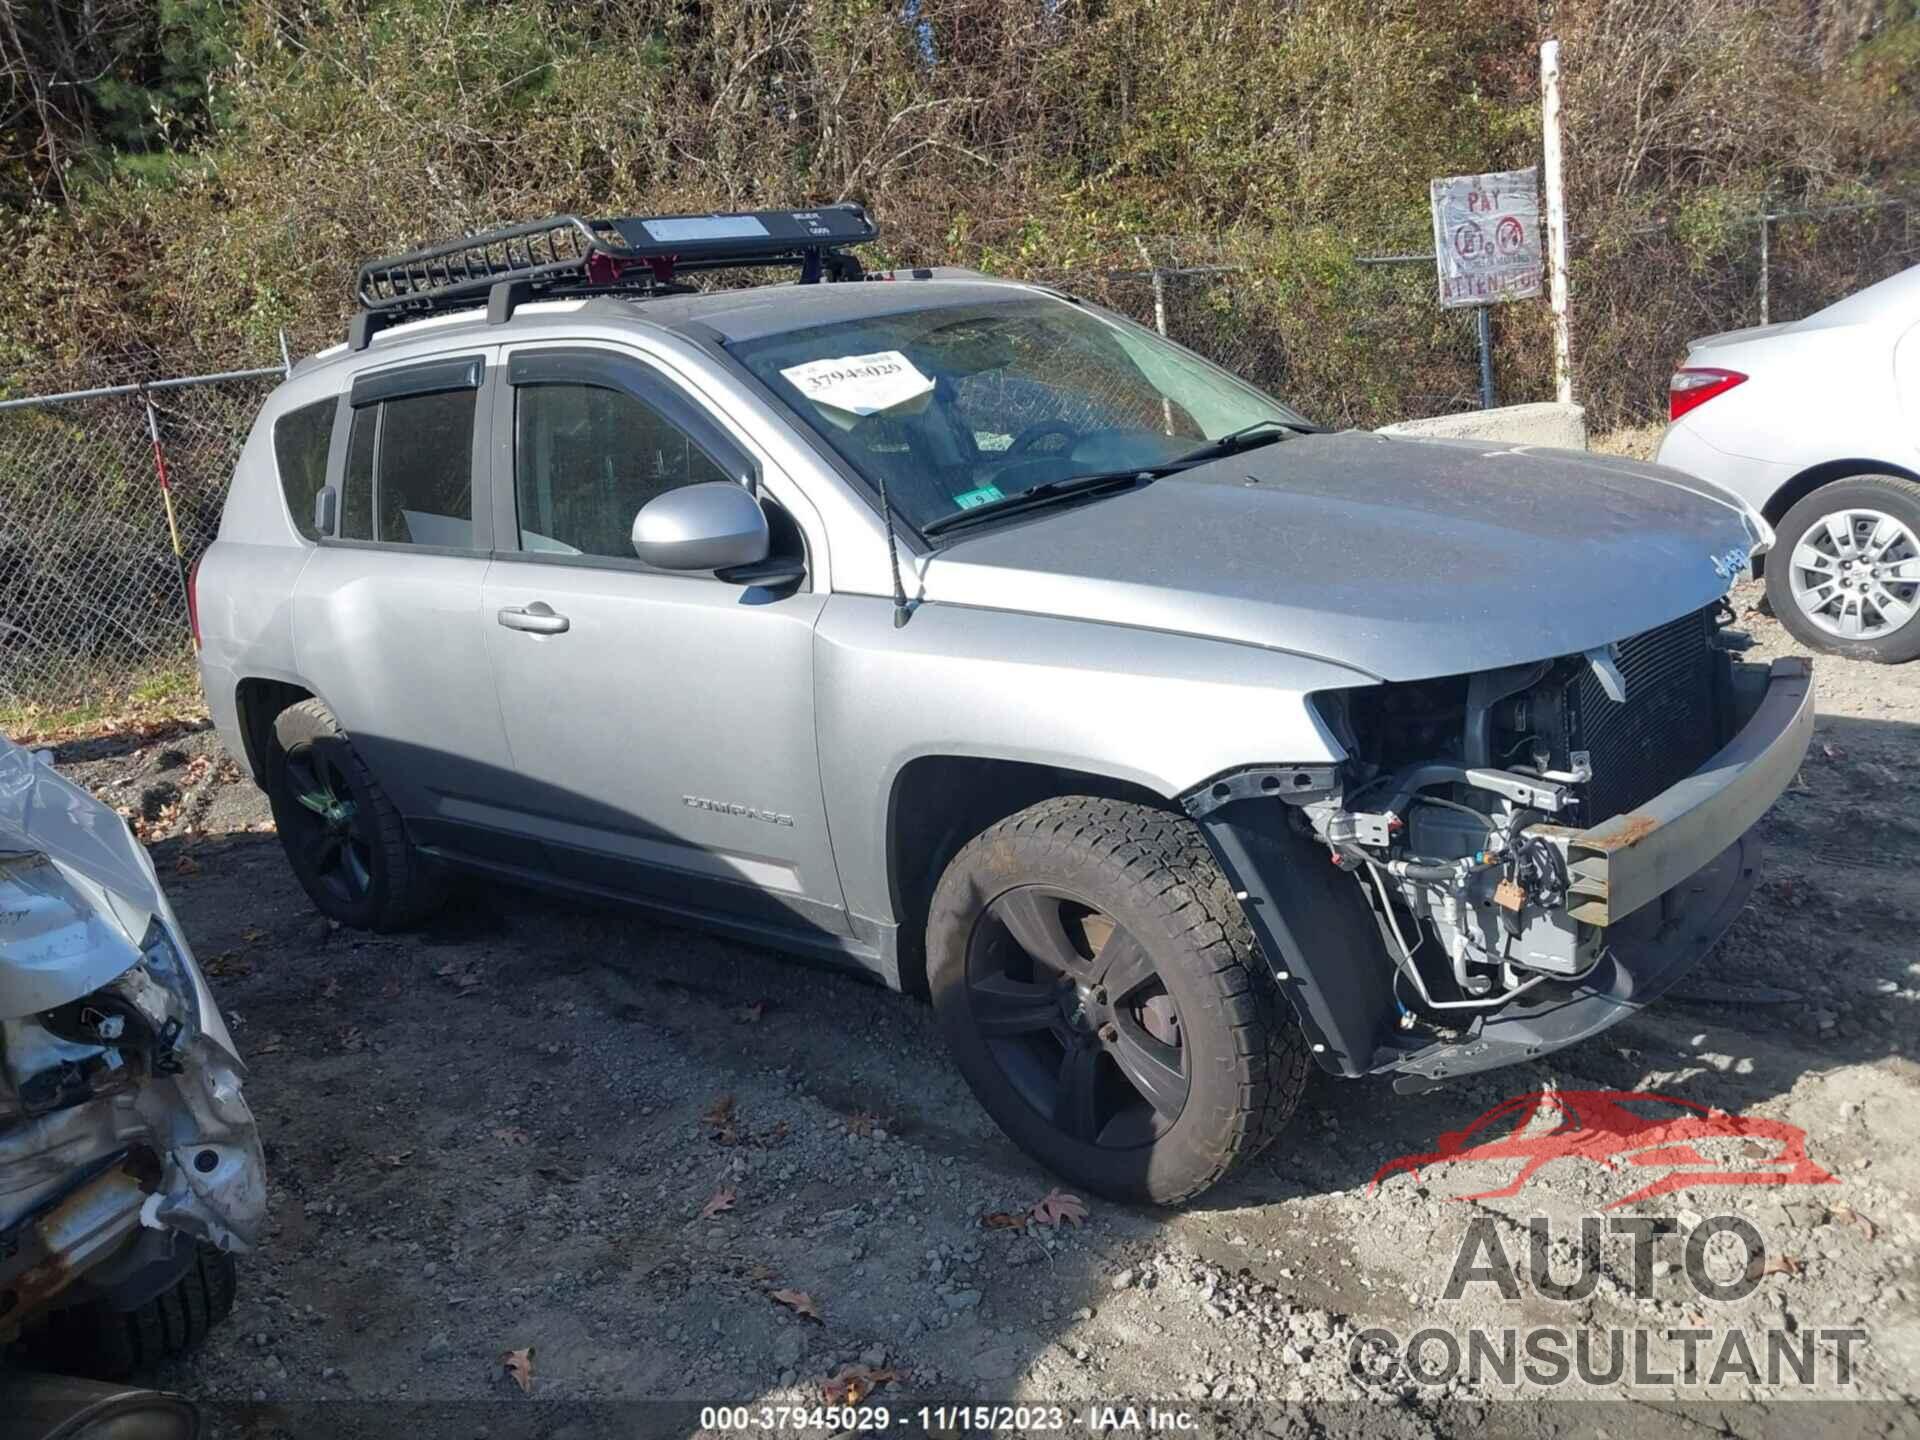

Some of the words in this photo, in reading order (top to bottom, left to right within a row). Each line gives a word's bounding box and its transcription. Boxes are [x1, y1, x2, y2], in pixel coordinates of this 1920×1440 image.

[1467, 189, 1500, 212] PAY
[806, 363, 902, 388] 37945029
[682, 795, 794, 827] COMPASS
